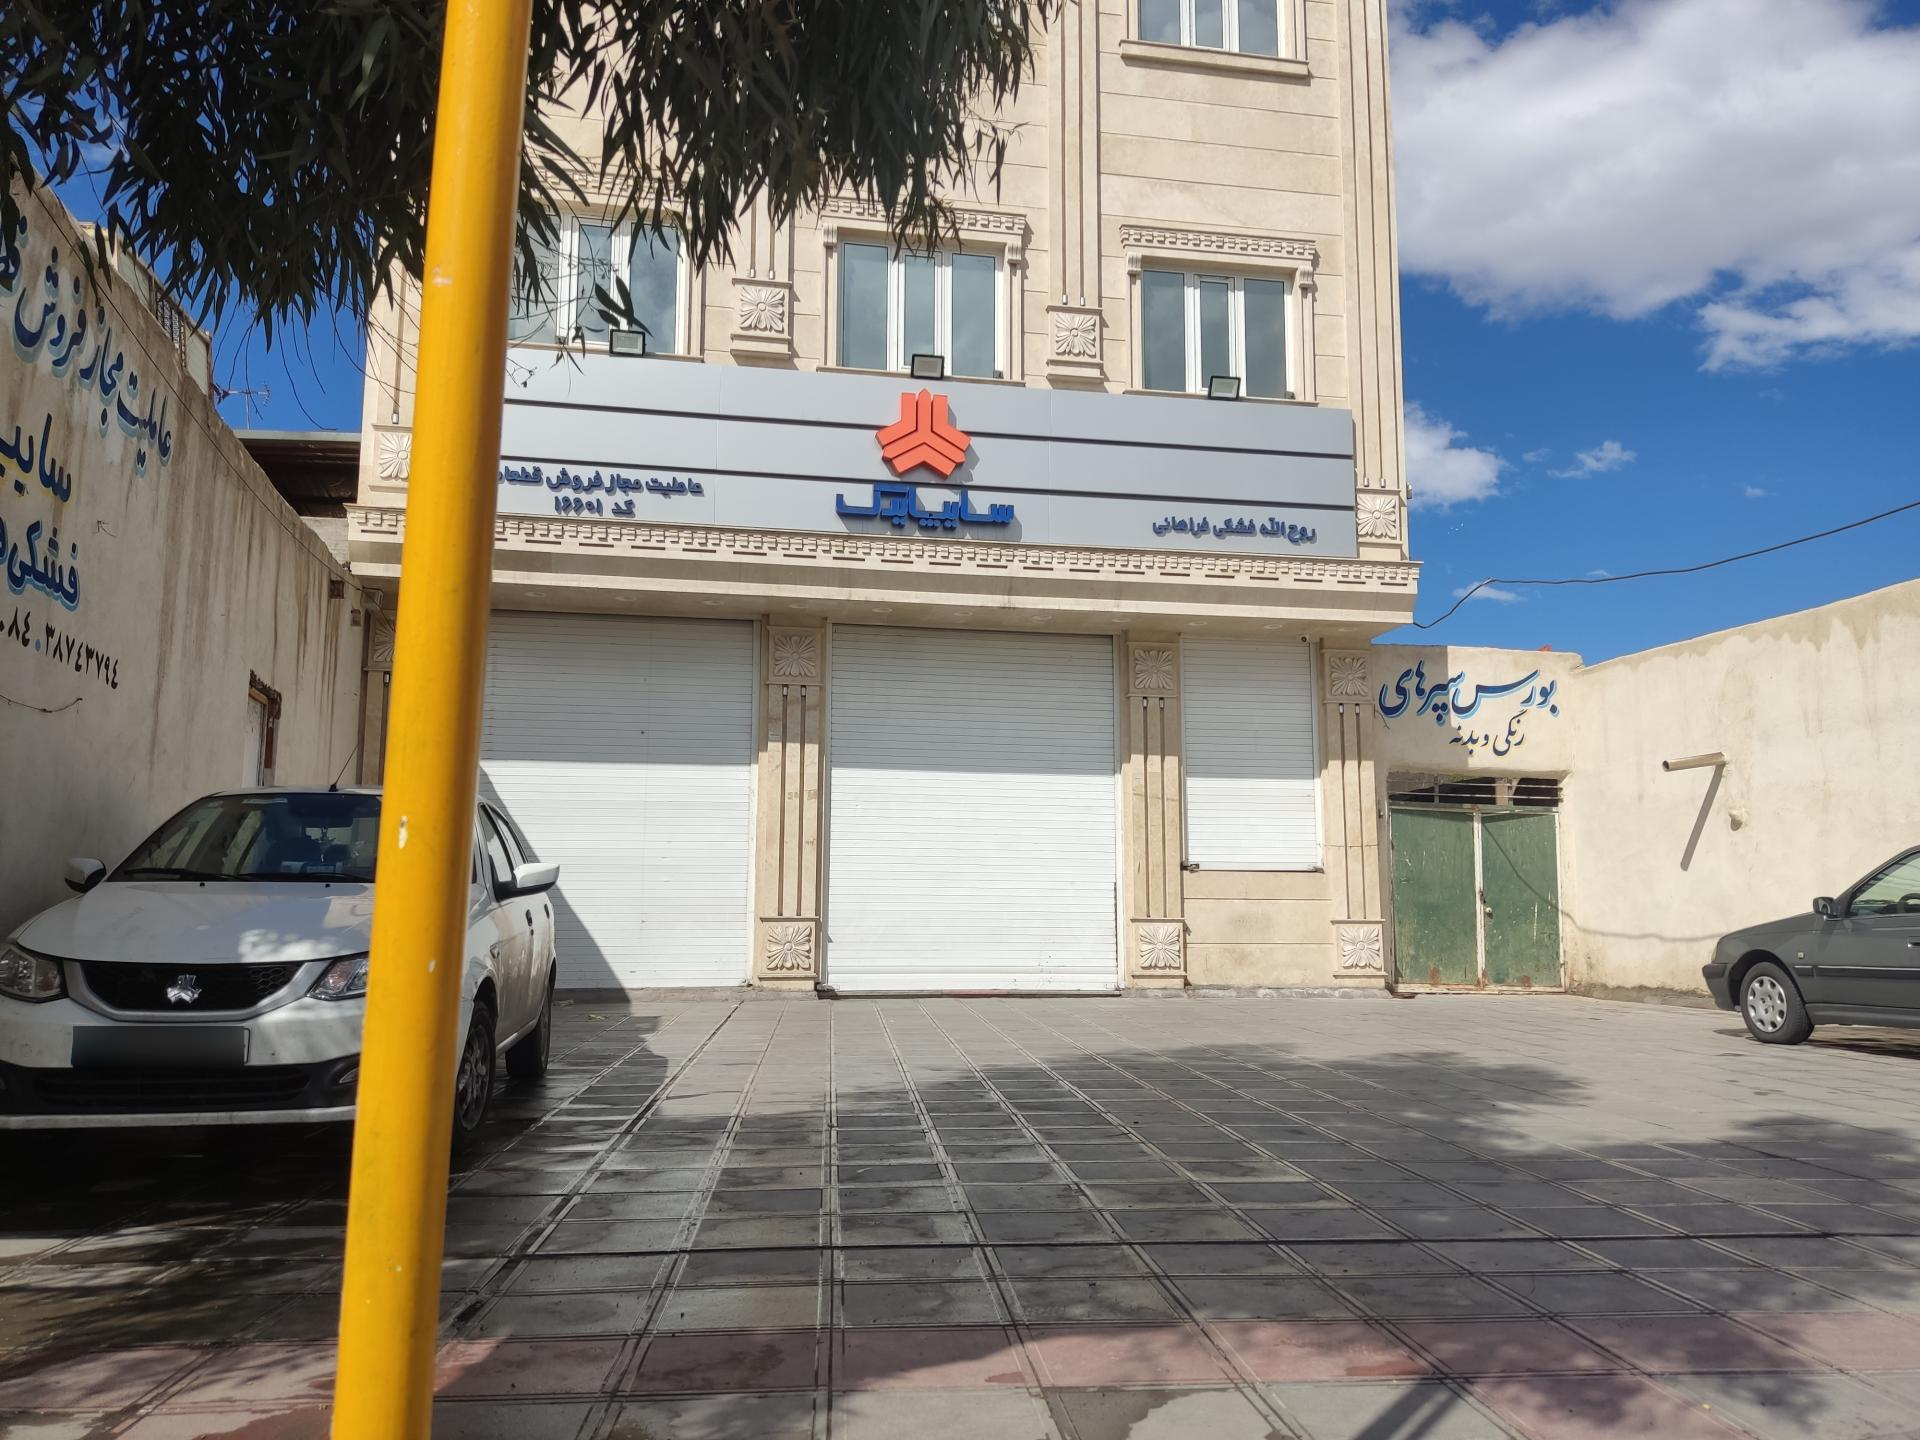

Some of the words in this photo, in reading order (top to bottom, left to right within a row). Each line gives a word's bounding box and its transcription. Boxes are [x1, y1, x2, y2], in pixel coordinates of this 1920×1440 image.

[14, 246, 87, 368] فروش
[79, 305, 124, 428] مجاز
[117, 374, 173, 470] عاملیت
[498, 465, 543, 484] قطعا
[546, 467, 604, 492] فروش
[605, 473, 643, 495] مجاز
[645, 476, 703, 498] عاملیت
[611, 499, 635, 516] کد
[1152, 516, 1210, 536] فراهانی
[1212, 517, 1256, 537] فشکی
[1287, 523, 1316, 543] روح
[7, 519, 80, 608] فشکی
[1379, 660, 1465, 725] سپرهای
[1451, 669, 1558, 717] بورس
[1449, 725, 1480, 755] بدنه
[1493, 709, 1527, 757] رنگی
